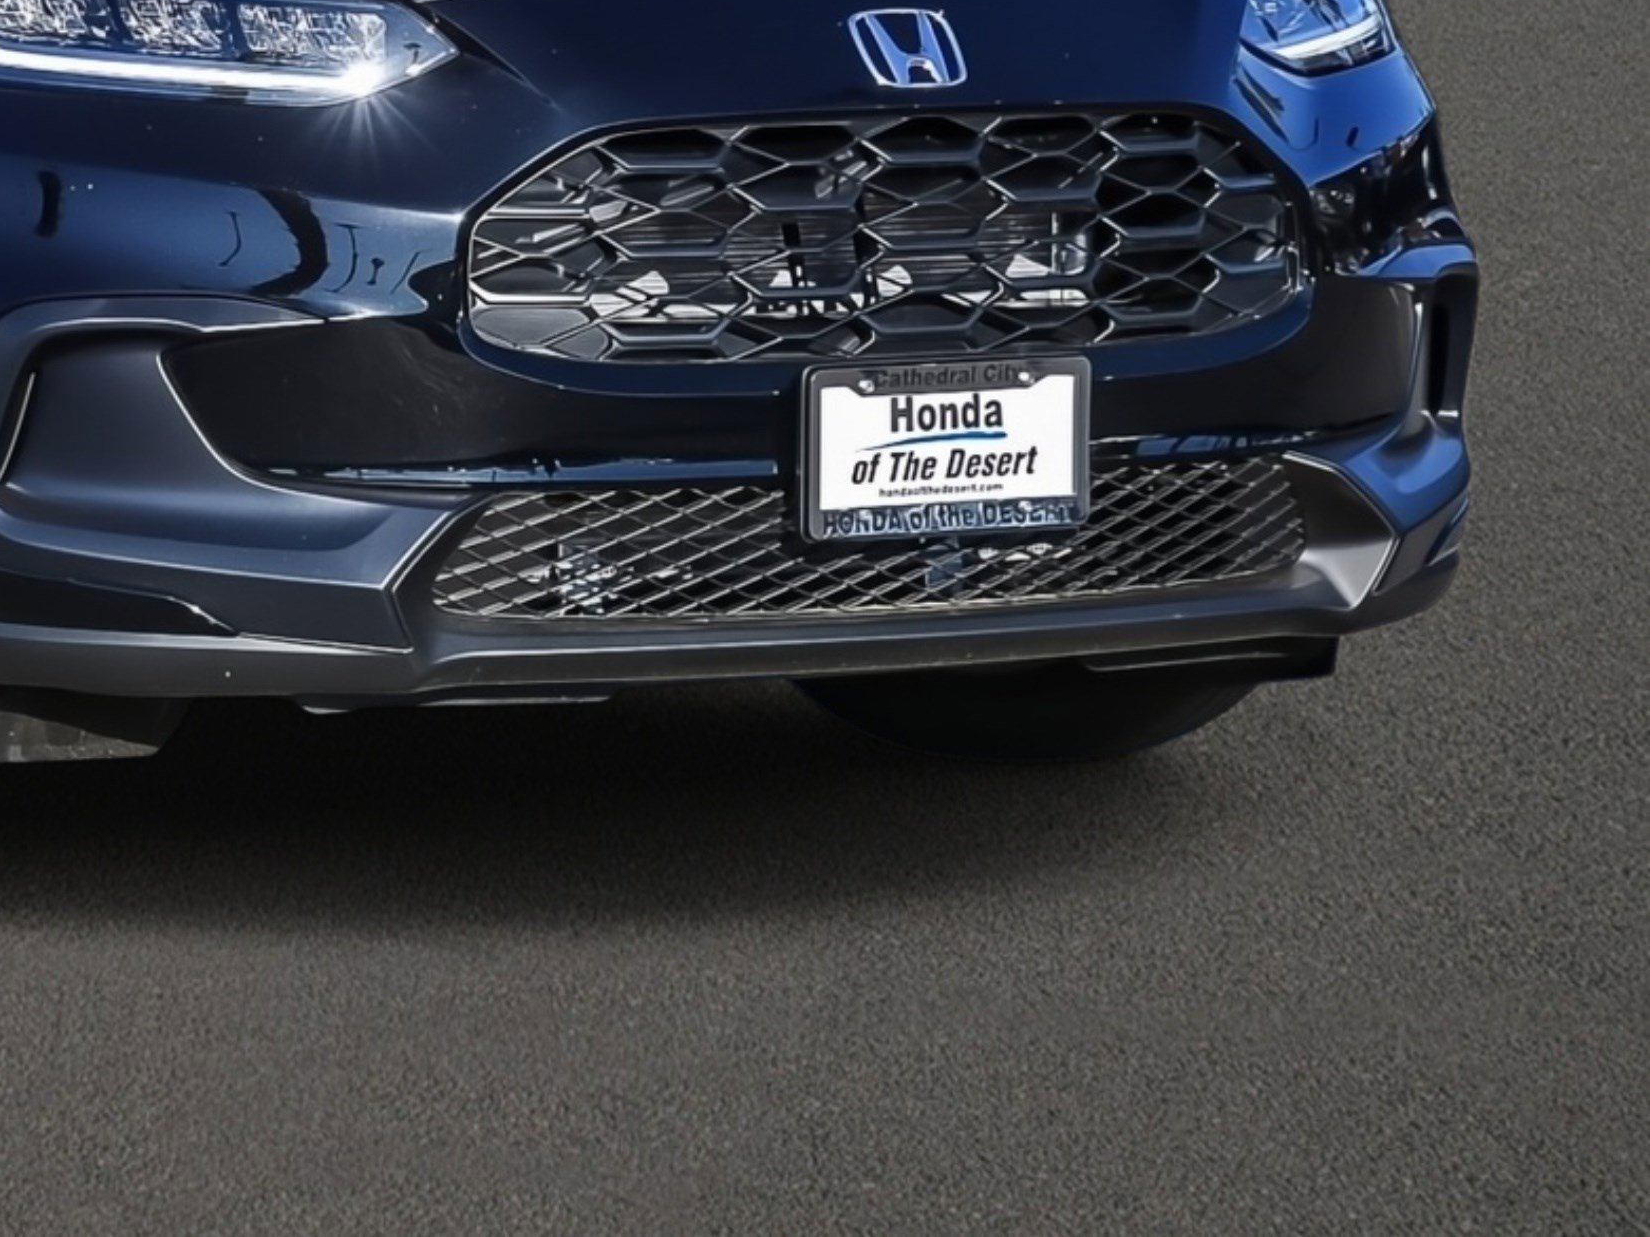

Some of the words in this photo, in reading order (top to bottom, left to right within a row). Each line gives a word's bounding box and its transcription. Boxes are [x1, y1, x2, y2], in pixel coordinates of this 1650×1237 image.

[876, 365, 976, 388] Cathedral
[889, 393, 1004, 433] Honda
[851, 452, 882, 485] of
[890, 449, 938, 483] The
[945, 445, 1038, 480] Desert
[824, 507, 906, 536] HONDA
